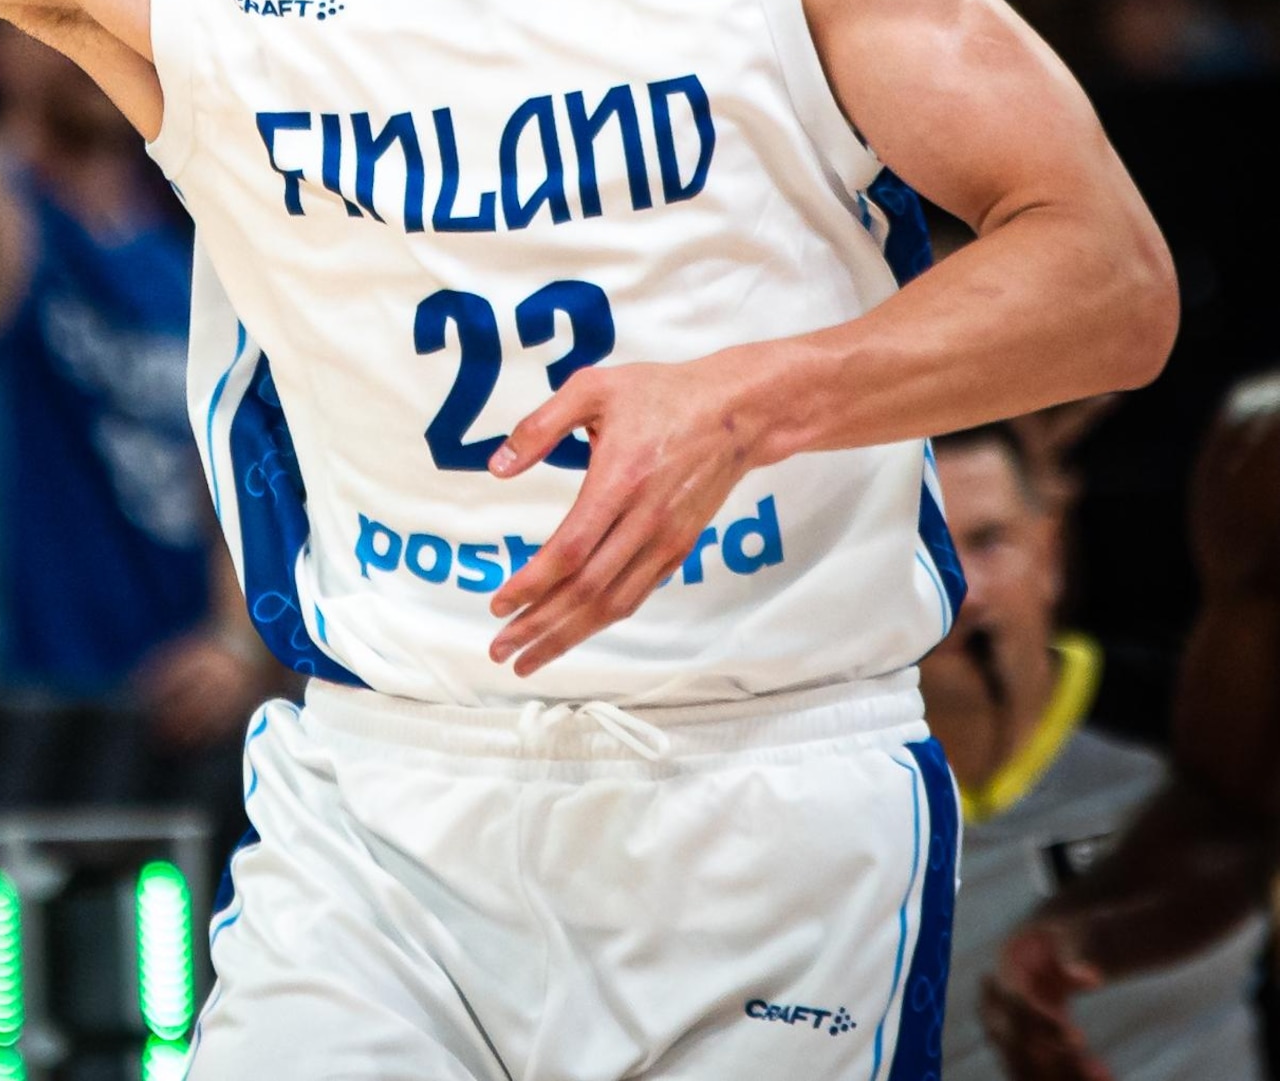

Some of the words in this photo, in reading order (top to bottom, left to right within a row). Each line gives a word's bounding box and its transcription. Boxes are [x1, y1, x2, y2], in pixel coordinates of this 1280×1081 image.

[255, 73, 716, 233] FINLAND
[413, 279, 616, 472] 23
[354, 494, 785, 594] postrd
